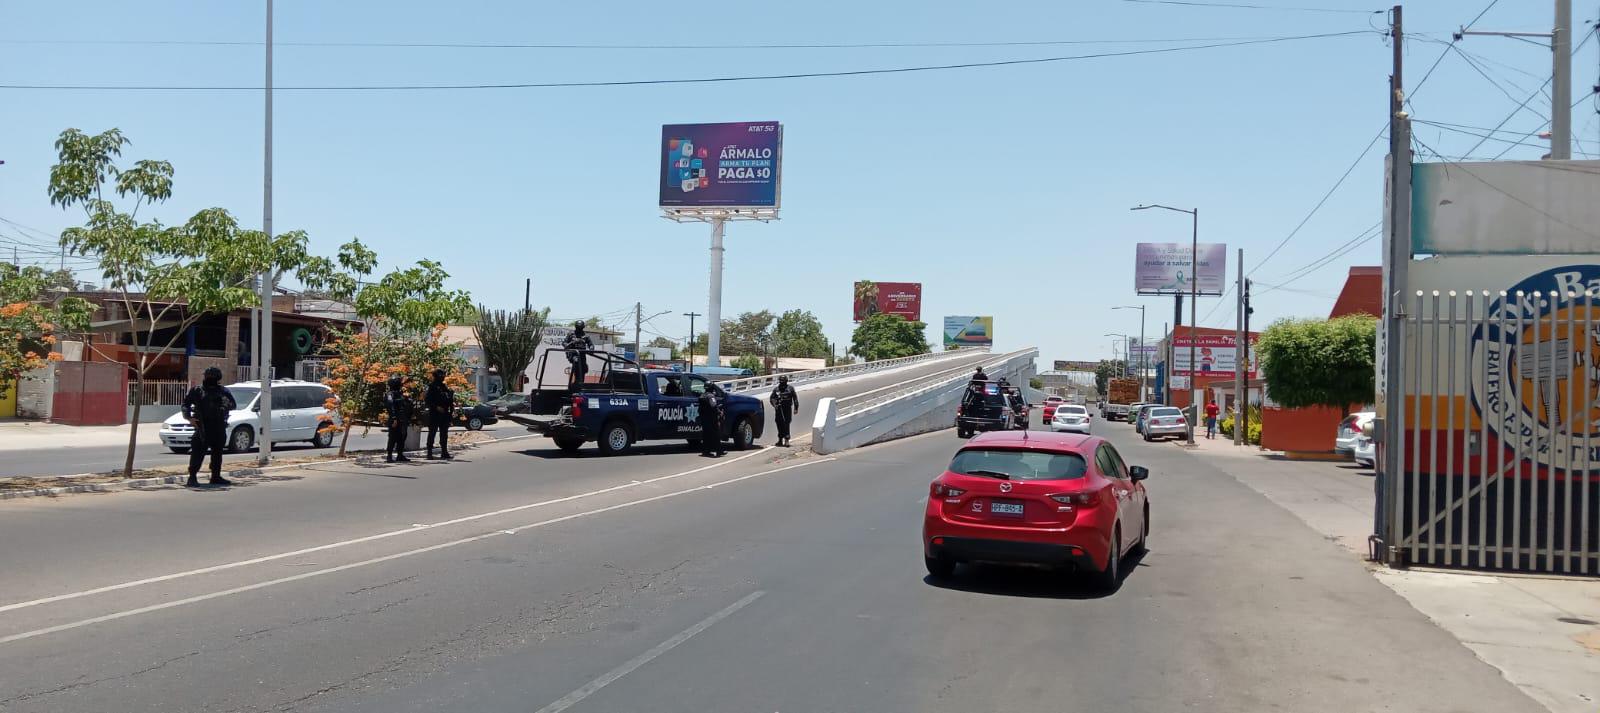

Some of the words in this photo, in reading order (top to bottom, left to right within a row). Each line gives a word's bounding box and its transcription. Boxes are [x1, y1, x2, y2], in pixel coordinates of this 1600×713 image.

[720, 147, 771, 159] ÁRMALO
[718, 168, 755, 178] PAGA
[757, 168, 770, 178] $0
[658, 405, 684, 421] POLICÍA
